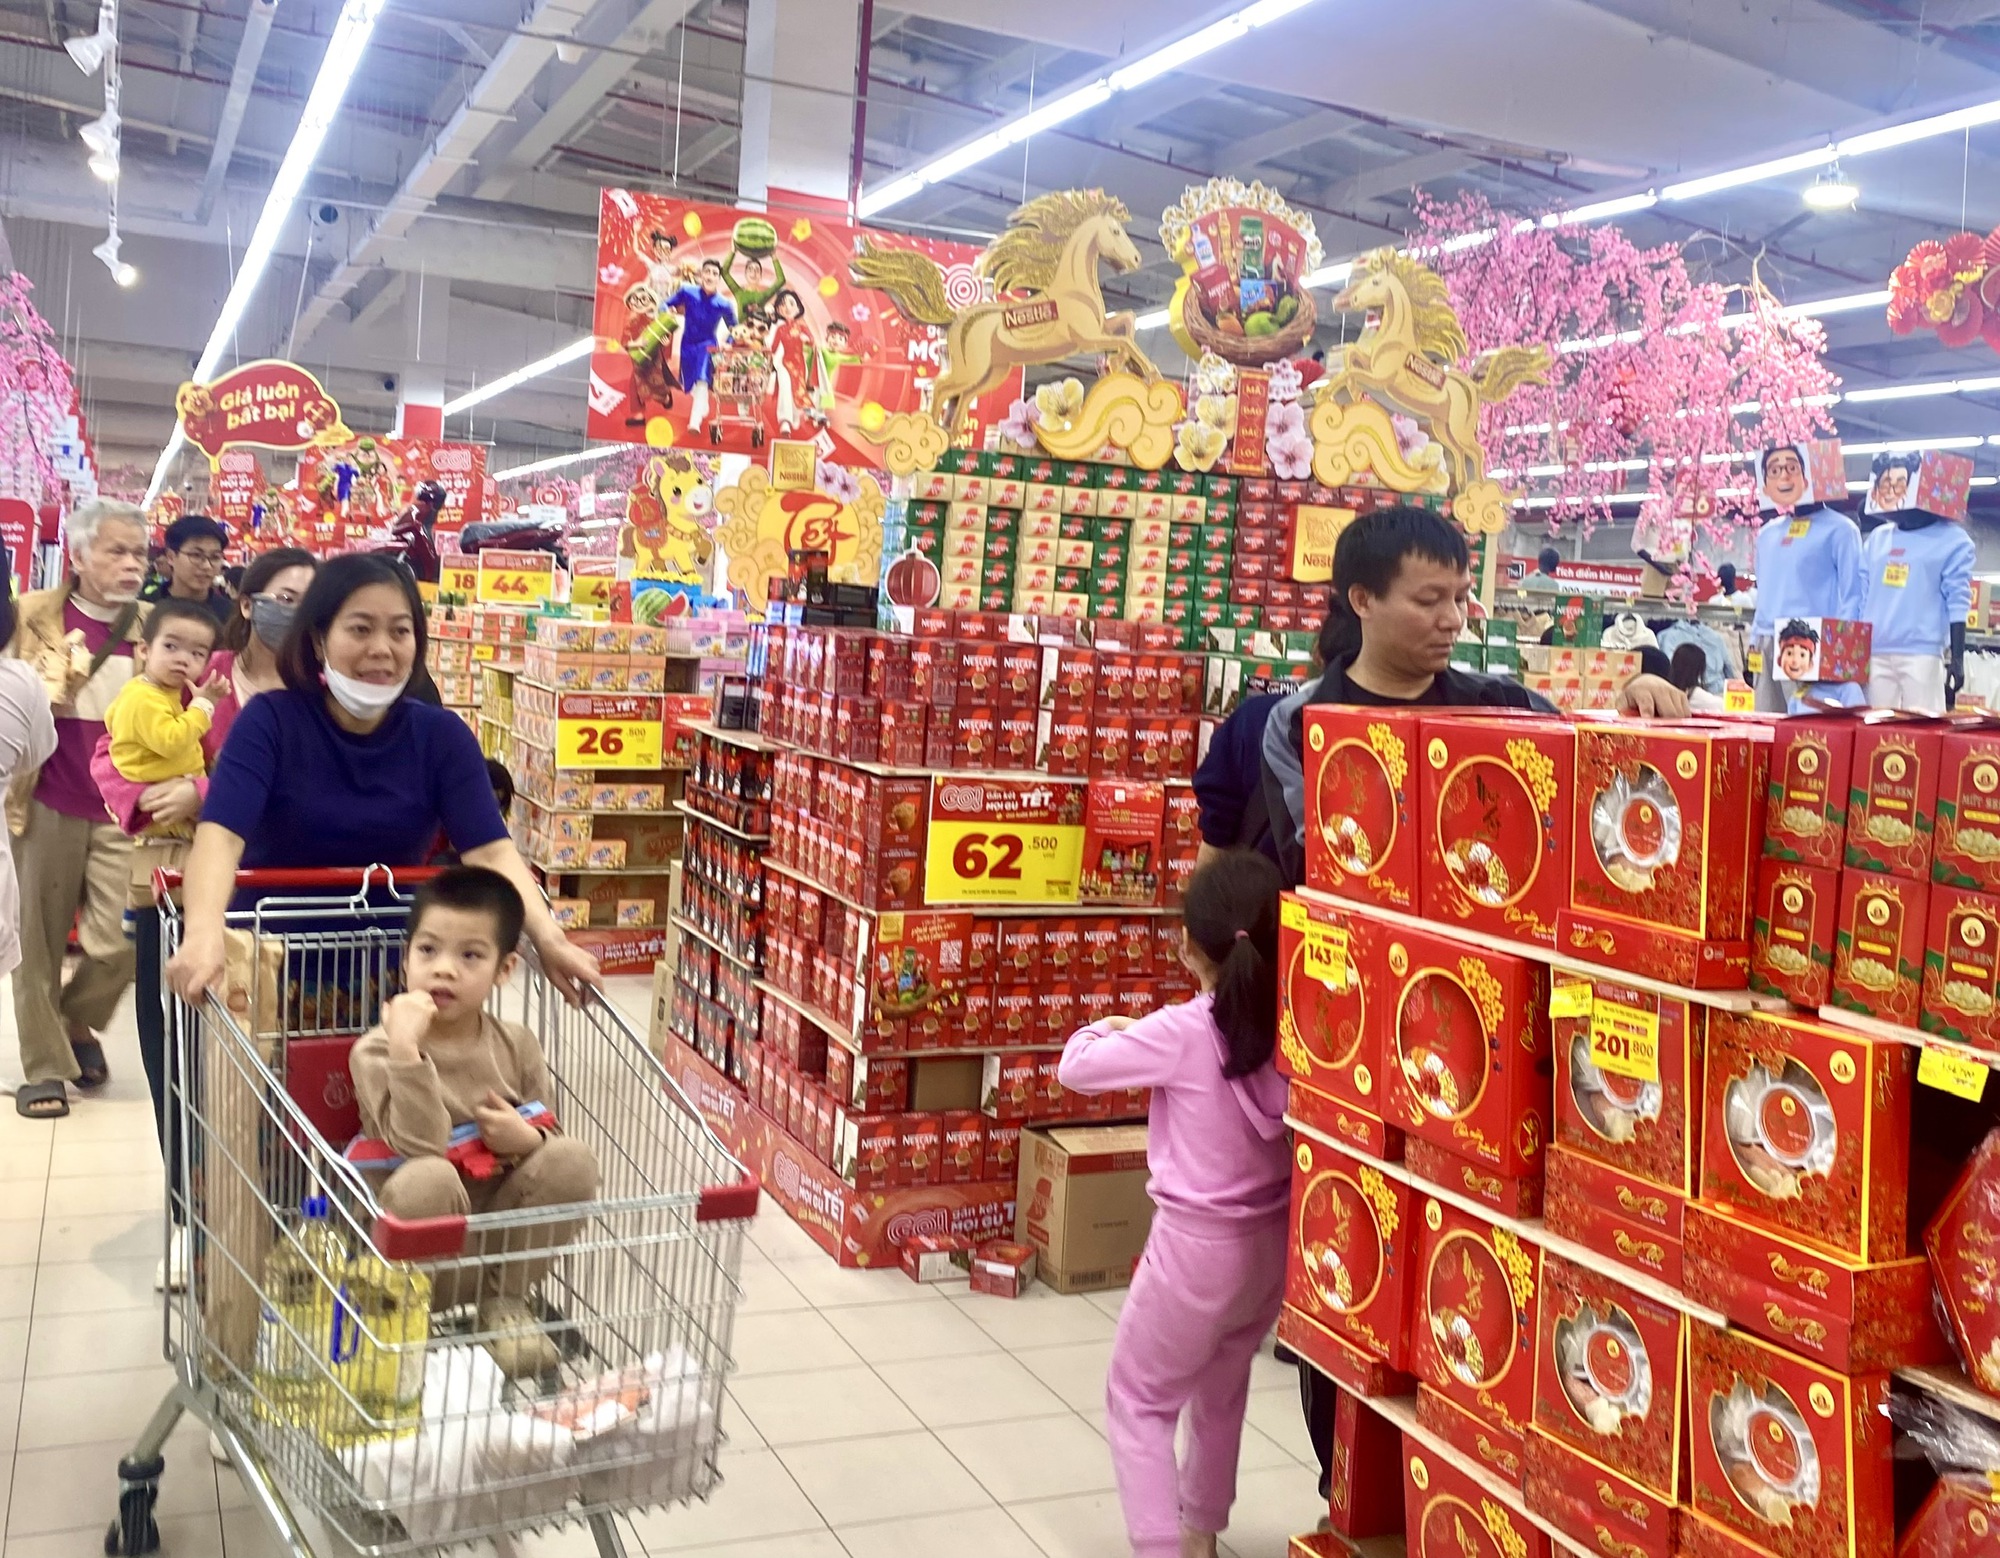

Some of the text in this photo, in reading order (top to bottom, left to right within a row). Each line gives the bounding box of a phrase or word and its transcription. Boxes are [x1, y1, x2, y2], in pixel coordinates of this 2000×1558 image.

[220, 381, 299, 411] Giá luôn
[227, 402, 295, 430] bất bại
[1302, 552, 1332, 568] Nest
[453, 573, 475, 589] 18
[492, 575, 529, 594] 44
[1600, 570, 1612, 581] khi
[1614, 573, 1633, 582] mua
[1730, 696, 1746, 707] 79
[577, 727, 623, 755] 26
[1020, 785, 1053, 807] TẾT
[953, 832, 1024, 879] 62
[1309, 943, 1331, 966] 143
[1594, 1031, 1629, 1060] 201
